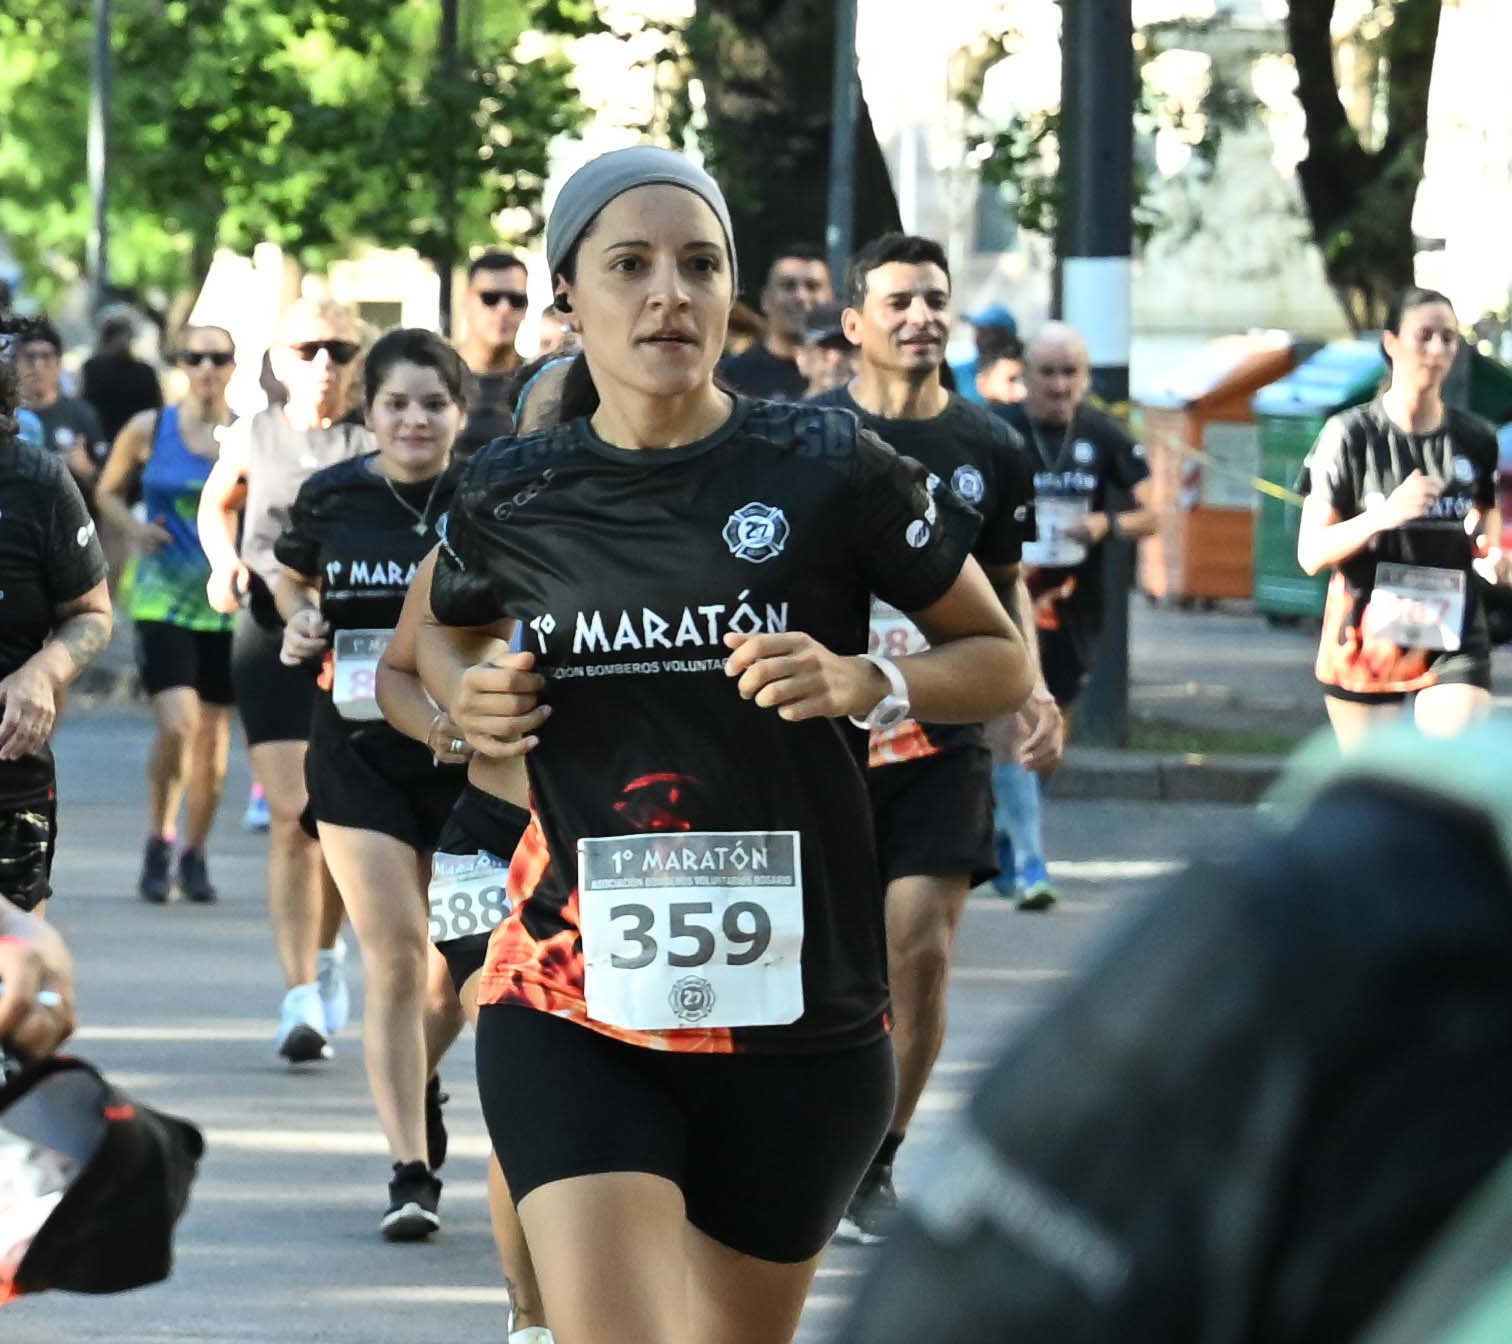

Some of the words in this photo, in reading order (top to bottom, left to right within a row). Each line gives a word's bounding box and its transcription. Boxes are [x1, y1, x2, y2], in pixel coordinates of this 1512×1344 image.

[745, 521, 769, 540] 27
[571, 589, 789, 655] MARATÓN
[586, 661, 660, 677] BOMBEROS
[642, 841, 769, 871] MARATÓN
[609, 901, 772, 970] 359
[684, 989, 702, 1006] 27
